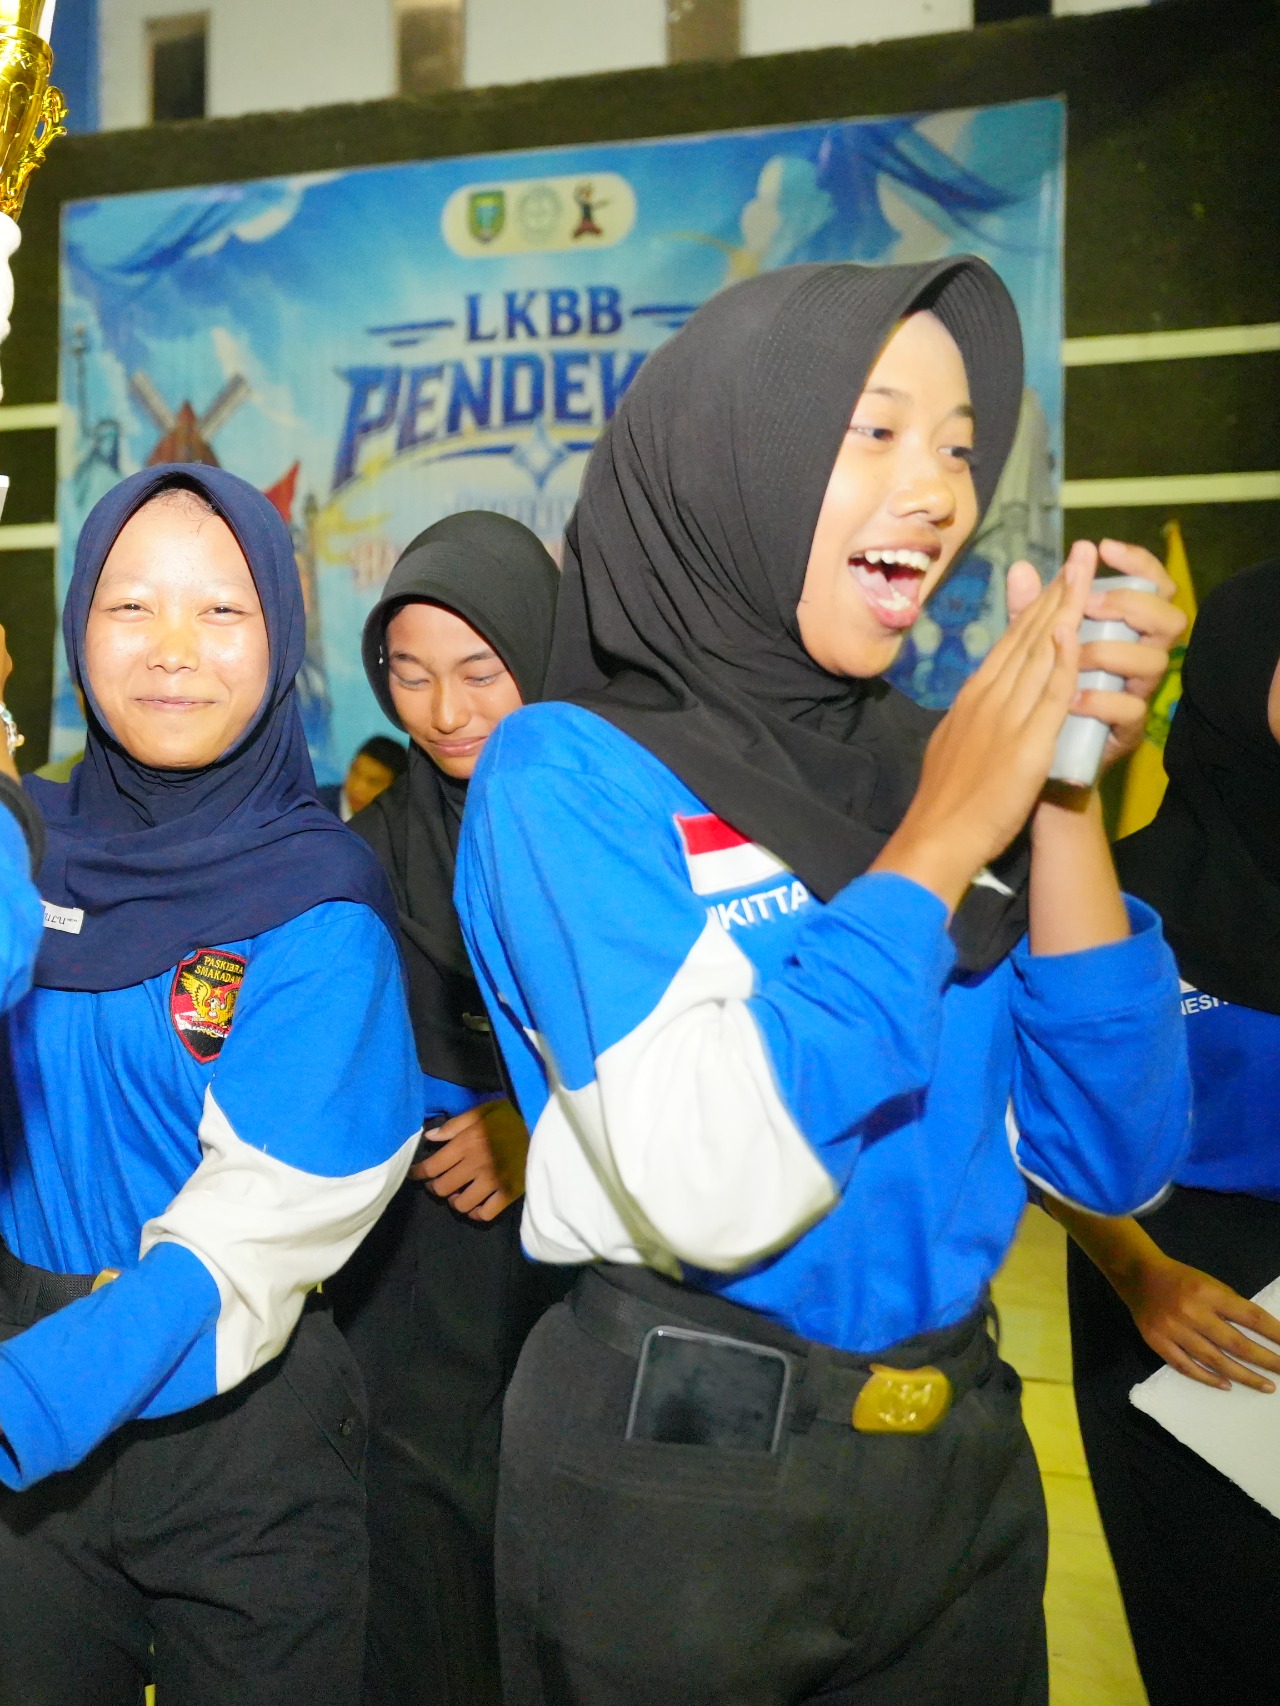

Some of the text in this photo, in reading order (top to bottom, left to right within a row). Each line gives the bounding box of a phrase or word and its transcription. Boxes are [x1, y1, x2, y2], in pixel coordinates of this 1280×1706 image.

[465, 285, 623, 343] LKBB
[331, 350, 649, 490] PENDEK
[705, 881, 809, 930] KITTA
[204, 956, 244, 974] PASKIBRA
